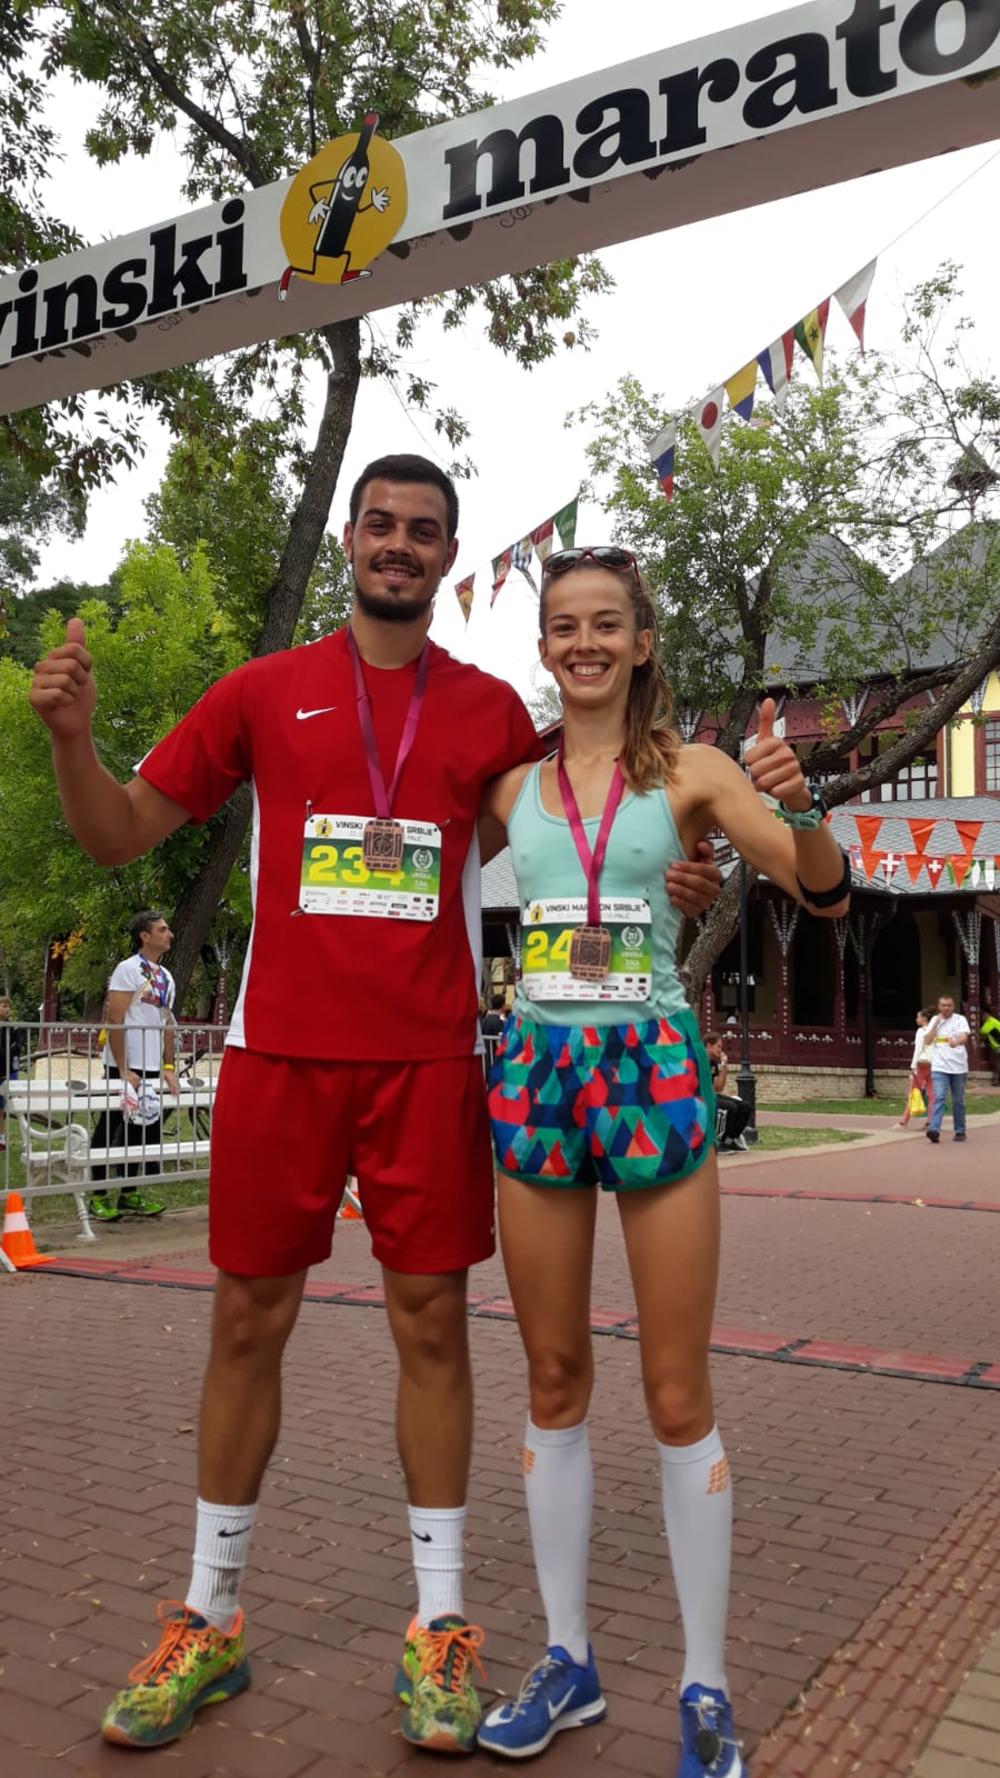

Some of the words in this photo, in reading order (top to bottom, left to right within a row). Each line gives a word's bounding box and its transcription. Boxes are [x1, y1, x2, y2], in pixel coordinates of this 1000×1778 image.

[0, 200, 248, 358] inski
[336, 820, 363, 830] VINSKI
[406, 825, 434, 837] SRBIJE
[545, 904, 570, 913] VINSKI
[613, 903, 641, 912] SRBIJE
